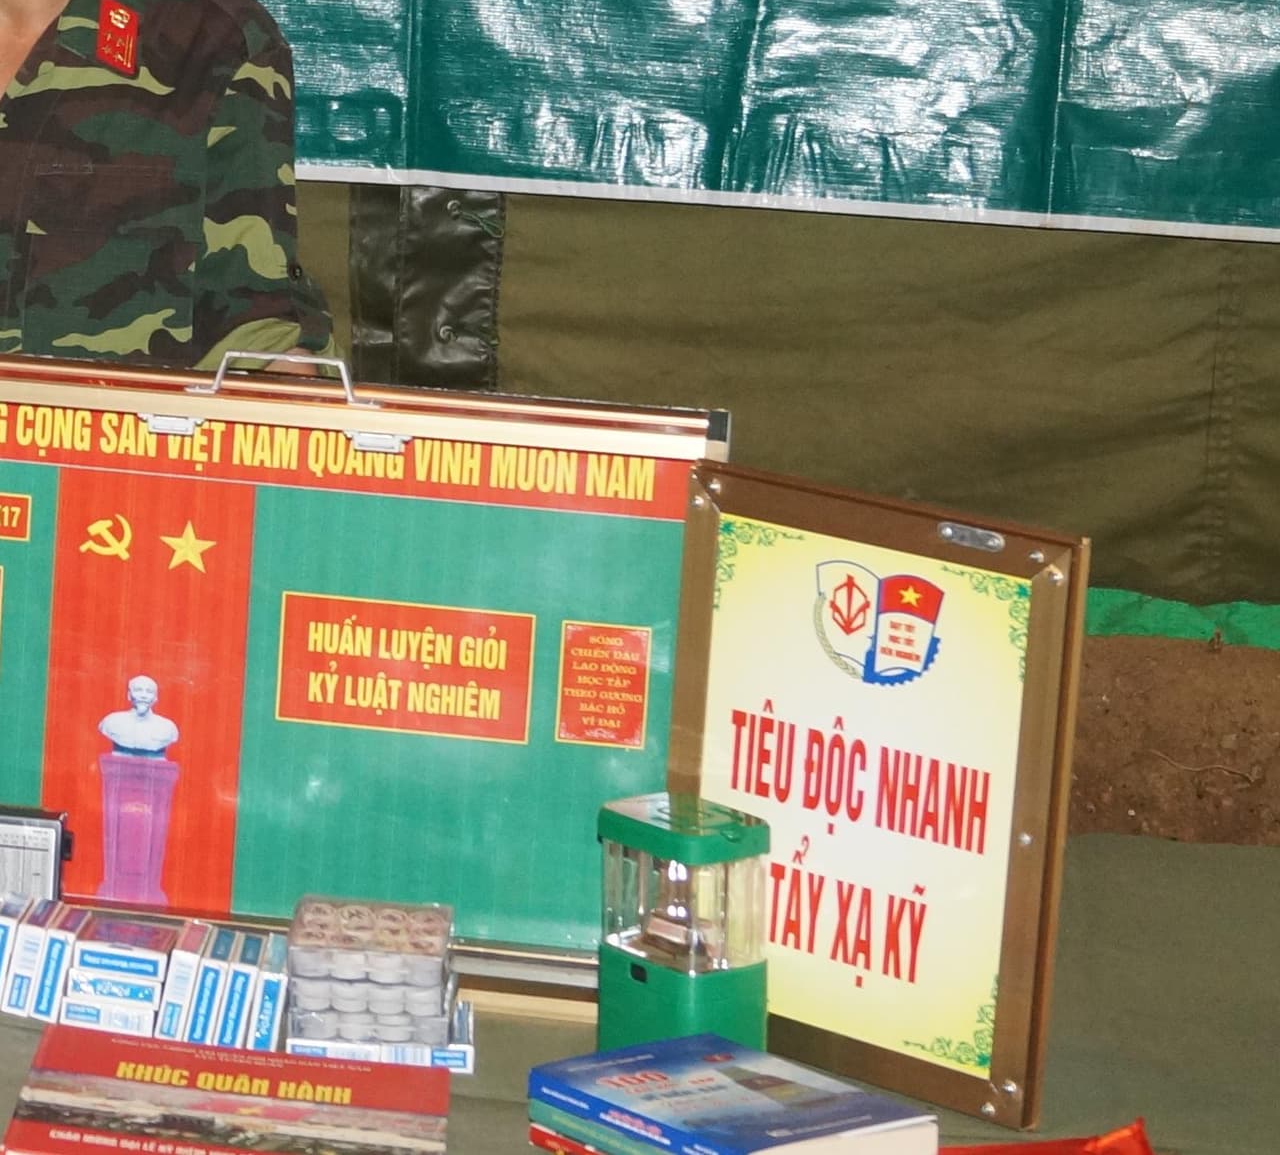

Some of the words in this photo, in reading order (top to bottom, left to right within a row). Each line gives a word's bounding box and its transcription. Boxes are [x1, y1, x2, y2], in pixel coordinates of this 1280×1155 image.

[233, 424, 299, 471] NAM
[307, 429, 406, 480] QUANG
[414, 438, 481, 487] VINH
[307, 614, 373, 658] HUẤN
[378, 626, 453, 670] LUYỆN
[458, 626, 508, 671] GIỎI
[307, 660, 339, 704] KỶ
[344, 671, 404, 716] LUẬT
[407, 680, 501, 721] NGHIÊM
[730, 699, 796, 804] TIÊU
[803, 716, 868, 836] ĐỘC
[875, 746, 992, 855] NHANH
[769, 835, 826, 955] TẨY
[830, 880, 874, 988] XẠ
[882, 884, 928, 984] KỸ
[116, 1060, 190, 1087] KHÚC
[196, 1071, 270, 1096] QUÂN
[277, 1080, 352, 1105] HÀNH
